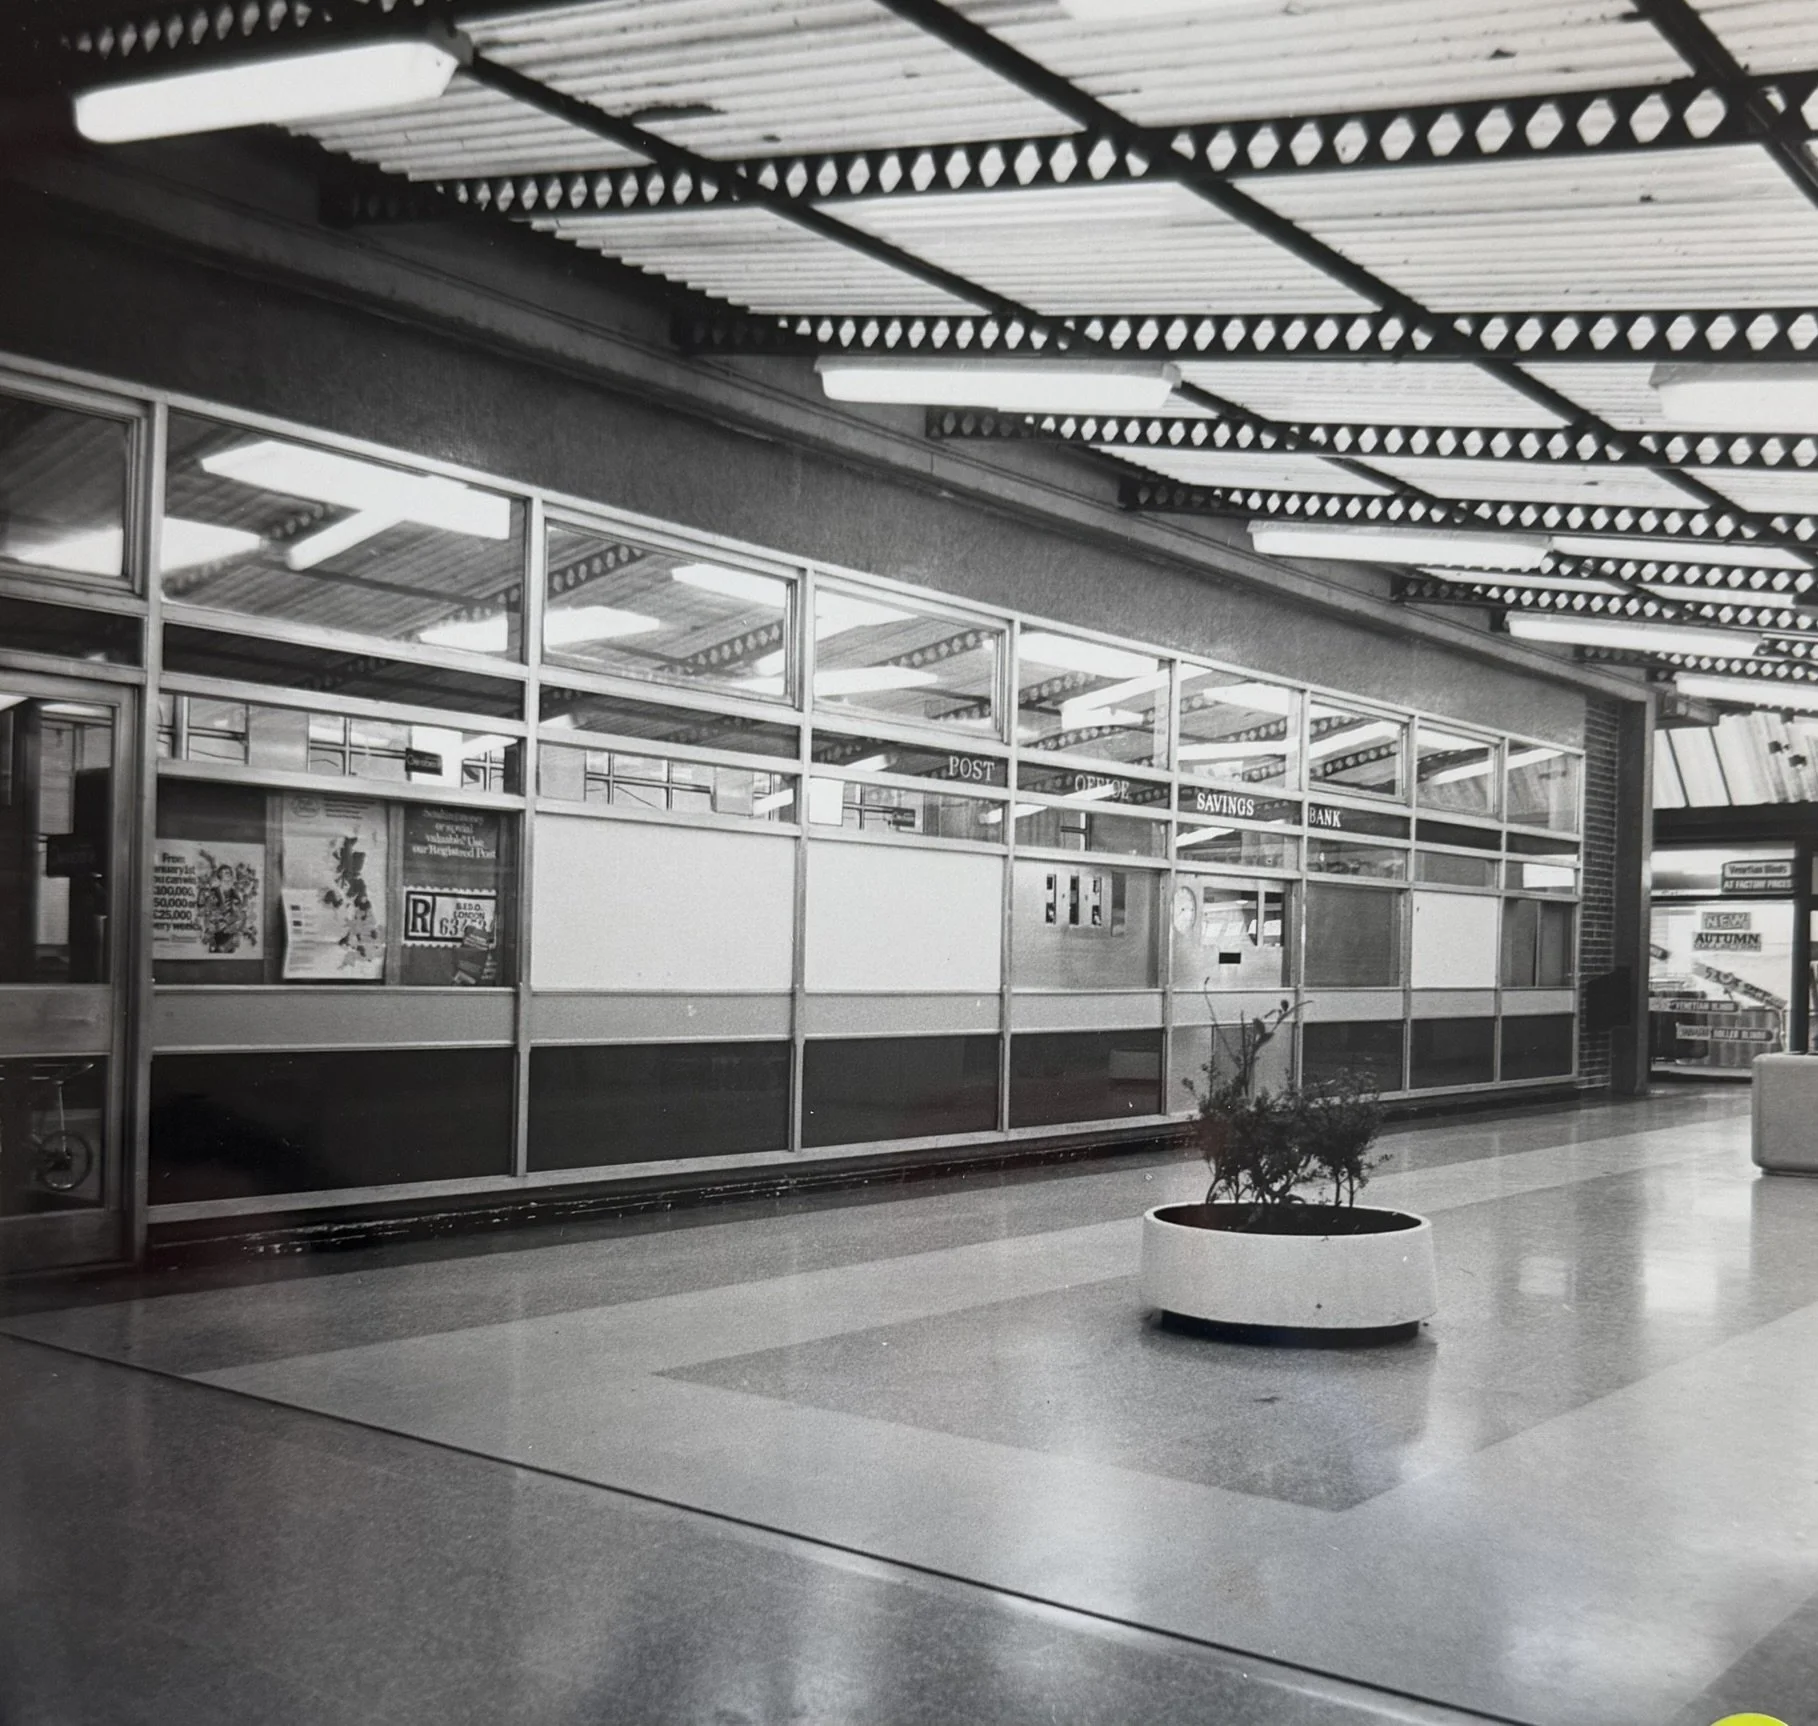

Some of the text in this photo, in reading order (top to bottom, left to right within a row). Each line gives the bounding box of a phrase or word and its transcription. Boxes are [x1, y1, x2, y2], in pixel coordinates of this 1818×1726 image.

[949, 755, 995, 781] POST
[1196, 792, 1255, 816] SAVINGS
[1309, 806, 1341, 828] BANK
[412, 898, 431, 933] R
[453, 911, 485, 919] LONDON
[1704, 914, 1747, 929] NEW
[1695, 933, 1760, 944] AUTUMN
